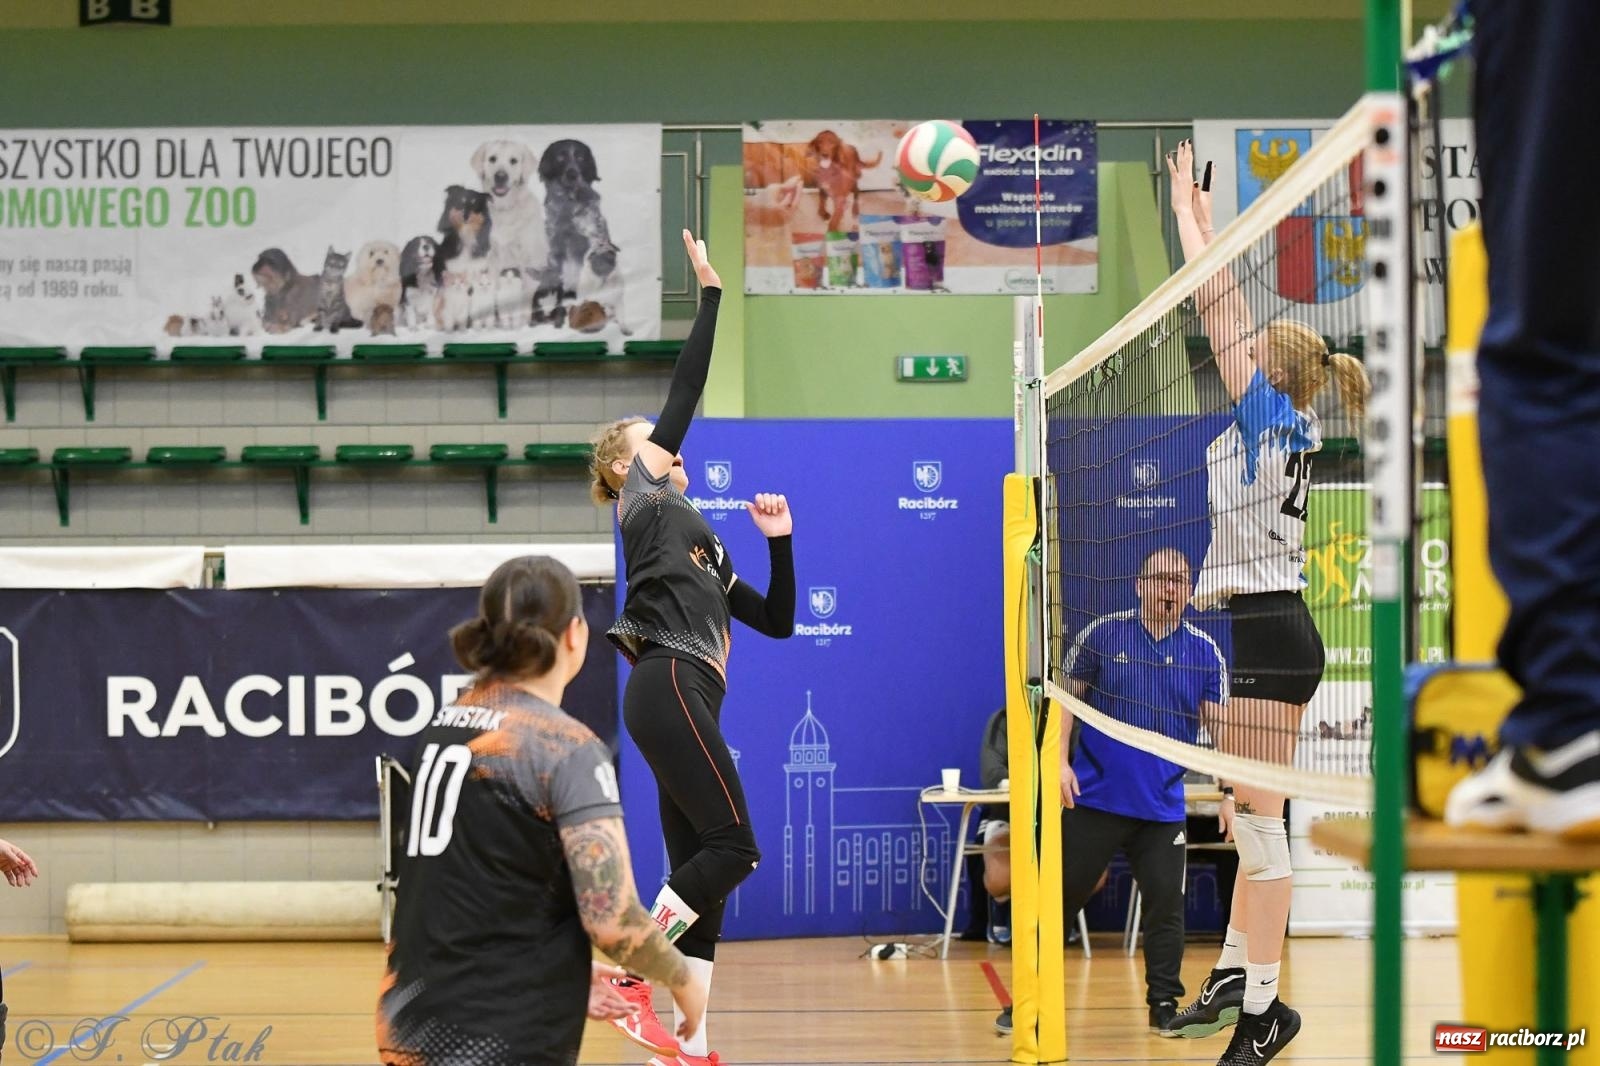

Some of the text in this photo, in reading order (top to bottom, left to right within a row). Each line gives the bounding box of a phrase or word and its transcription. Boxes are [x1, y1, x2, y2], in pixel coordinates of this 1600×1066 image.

[155, 138, 220, 179] DLA
[232, 137, 393, 178] TWOJEGO
[977, 143, 1083, 164] Flexadin
[0, 186, 256, 229] MOWEGO ZOO
[45, 258, 88, 277] naszą
[17, 279, 36, 298] od
[42, 279, 79, 298] 1989
[692, 497, 748, 510] Racibórz
[898, 496, 959, 510] Racibórz
[795, 623, 853, 636] Racibórz
[107, 652, 474, 738] RACIBÓ
[406, 743, 472, 857] 10
